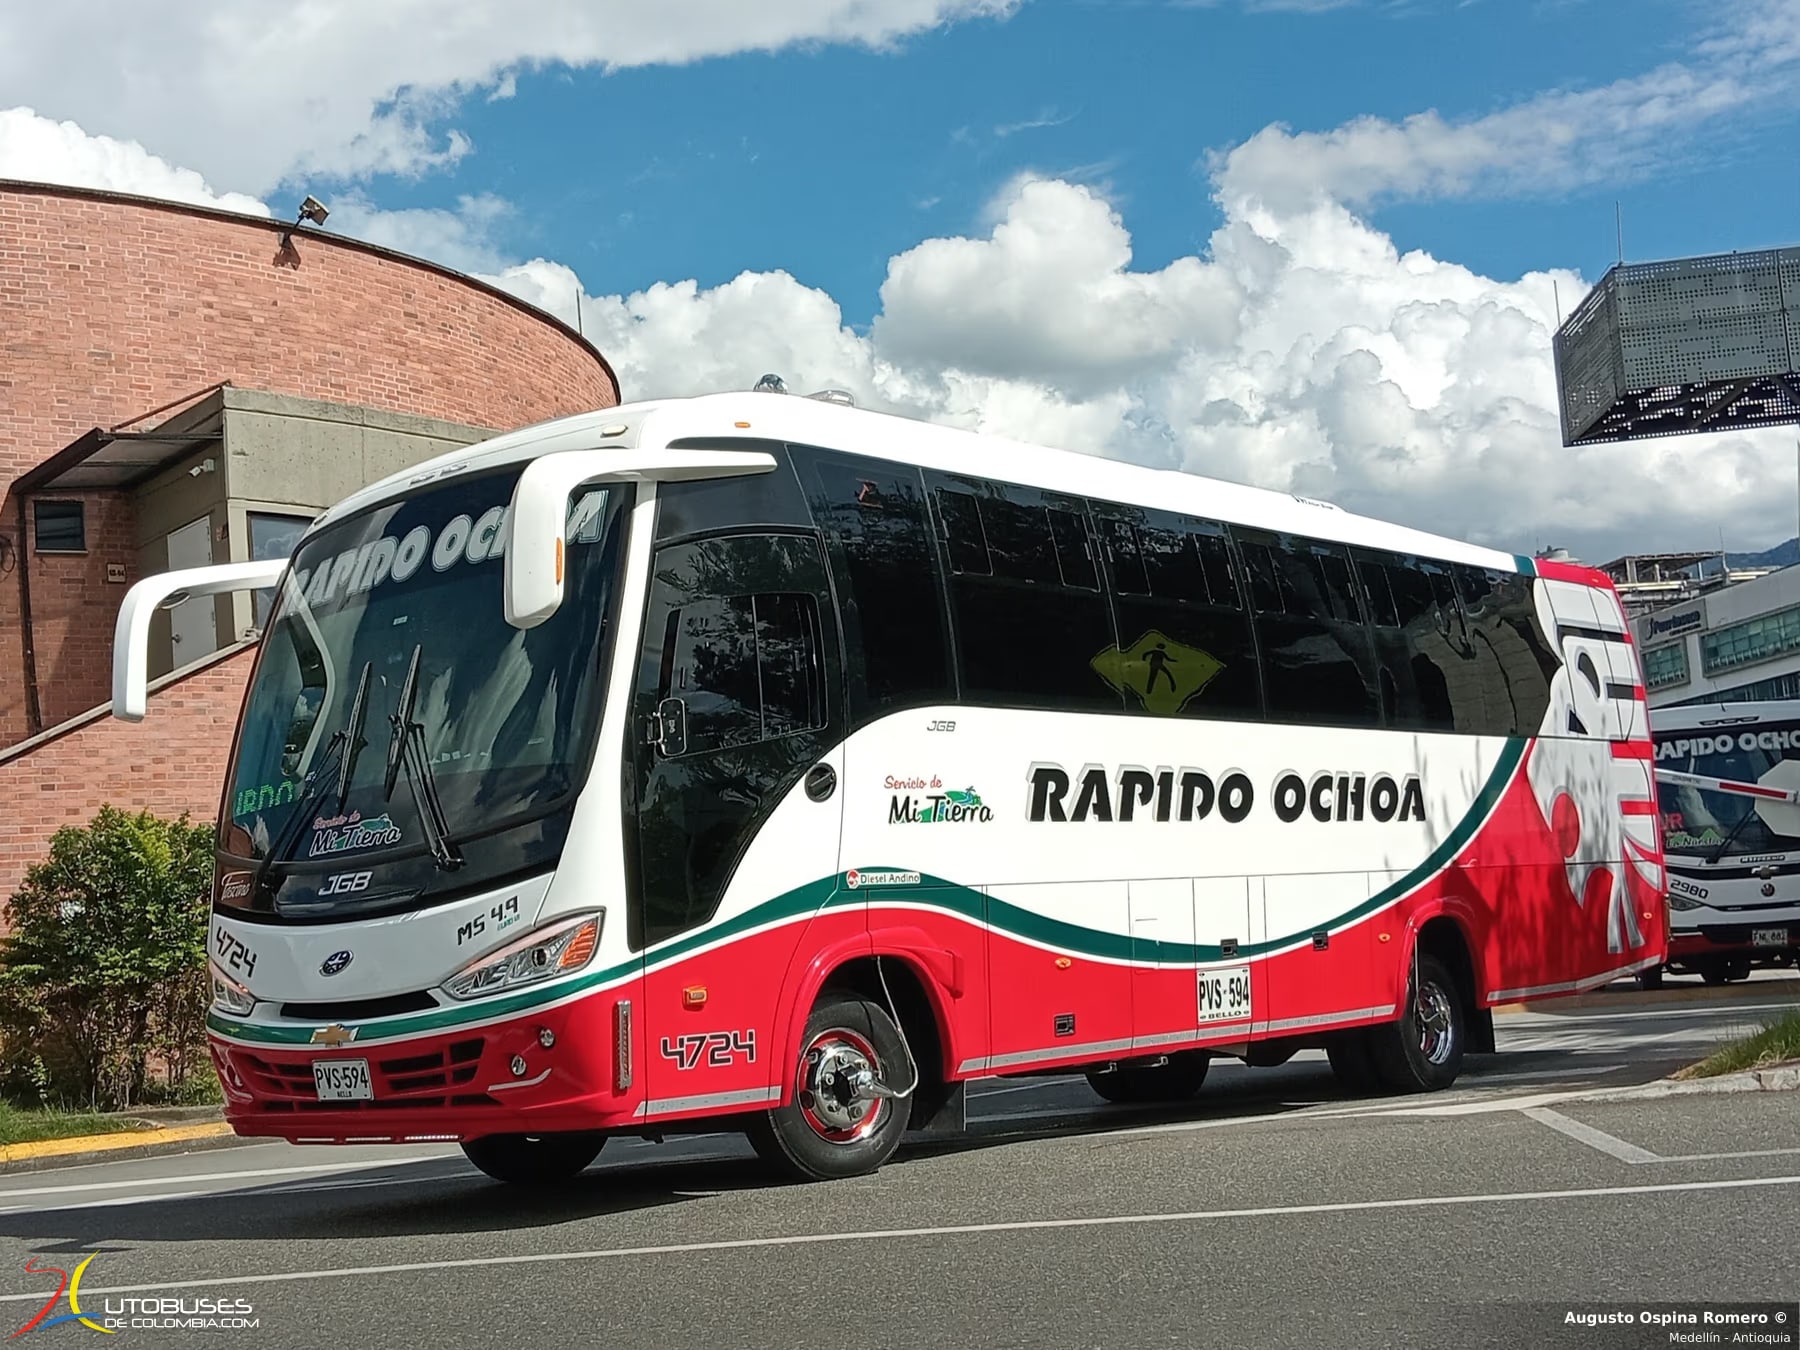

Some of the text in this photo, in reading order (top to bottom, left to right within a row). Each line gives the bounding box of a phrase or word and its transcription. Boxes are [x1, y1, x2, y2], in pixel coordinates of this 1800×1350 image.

[927, 720, 956, 732] JGB
[884, 774, 942, 790] Servicio de
[1025, 761, 1427, 823] RAPIDO OCHOA
[888, 795, 994, 824] Mi Tierra
[309, 825, 401, 857] Mi Tierra
[318, 871, 373, 896] JGB
[860, 873, 920, 884] Diesel Andino
[1670, 880, 1709, 899] 2980
[458, 896, 518, 946] MS 4.9
[216, 926, 258, 978] 4724
[1208, 1011, 1242, 1019] BELLO
[660, 1029, 756, 1071] 4724
